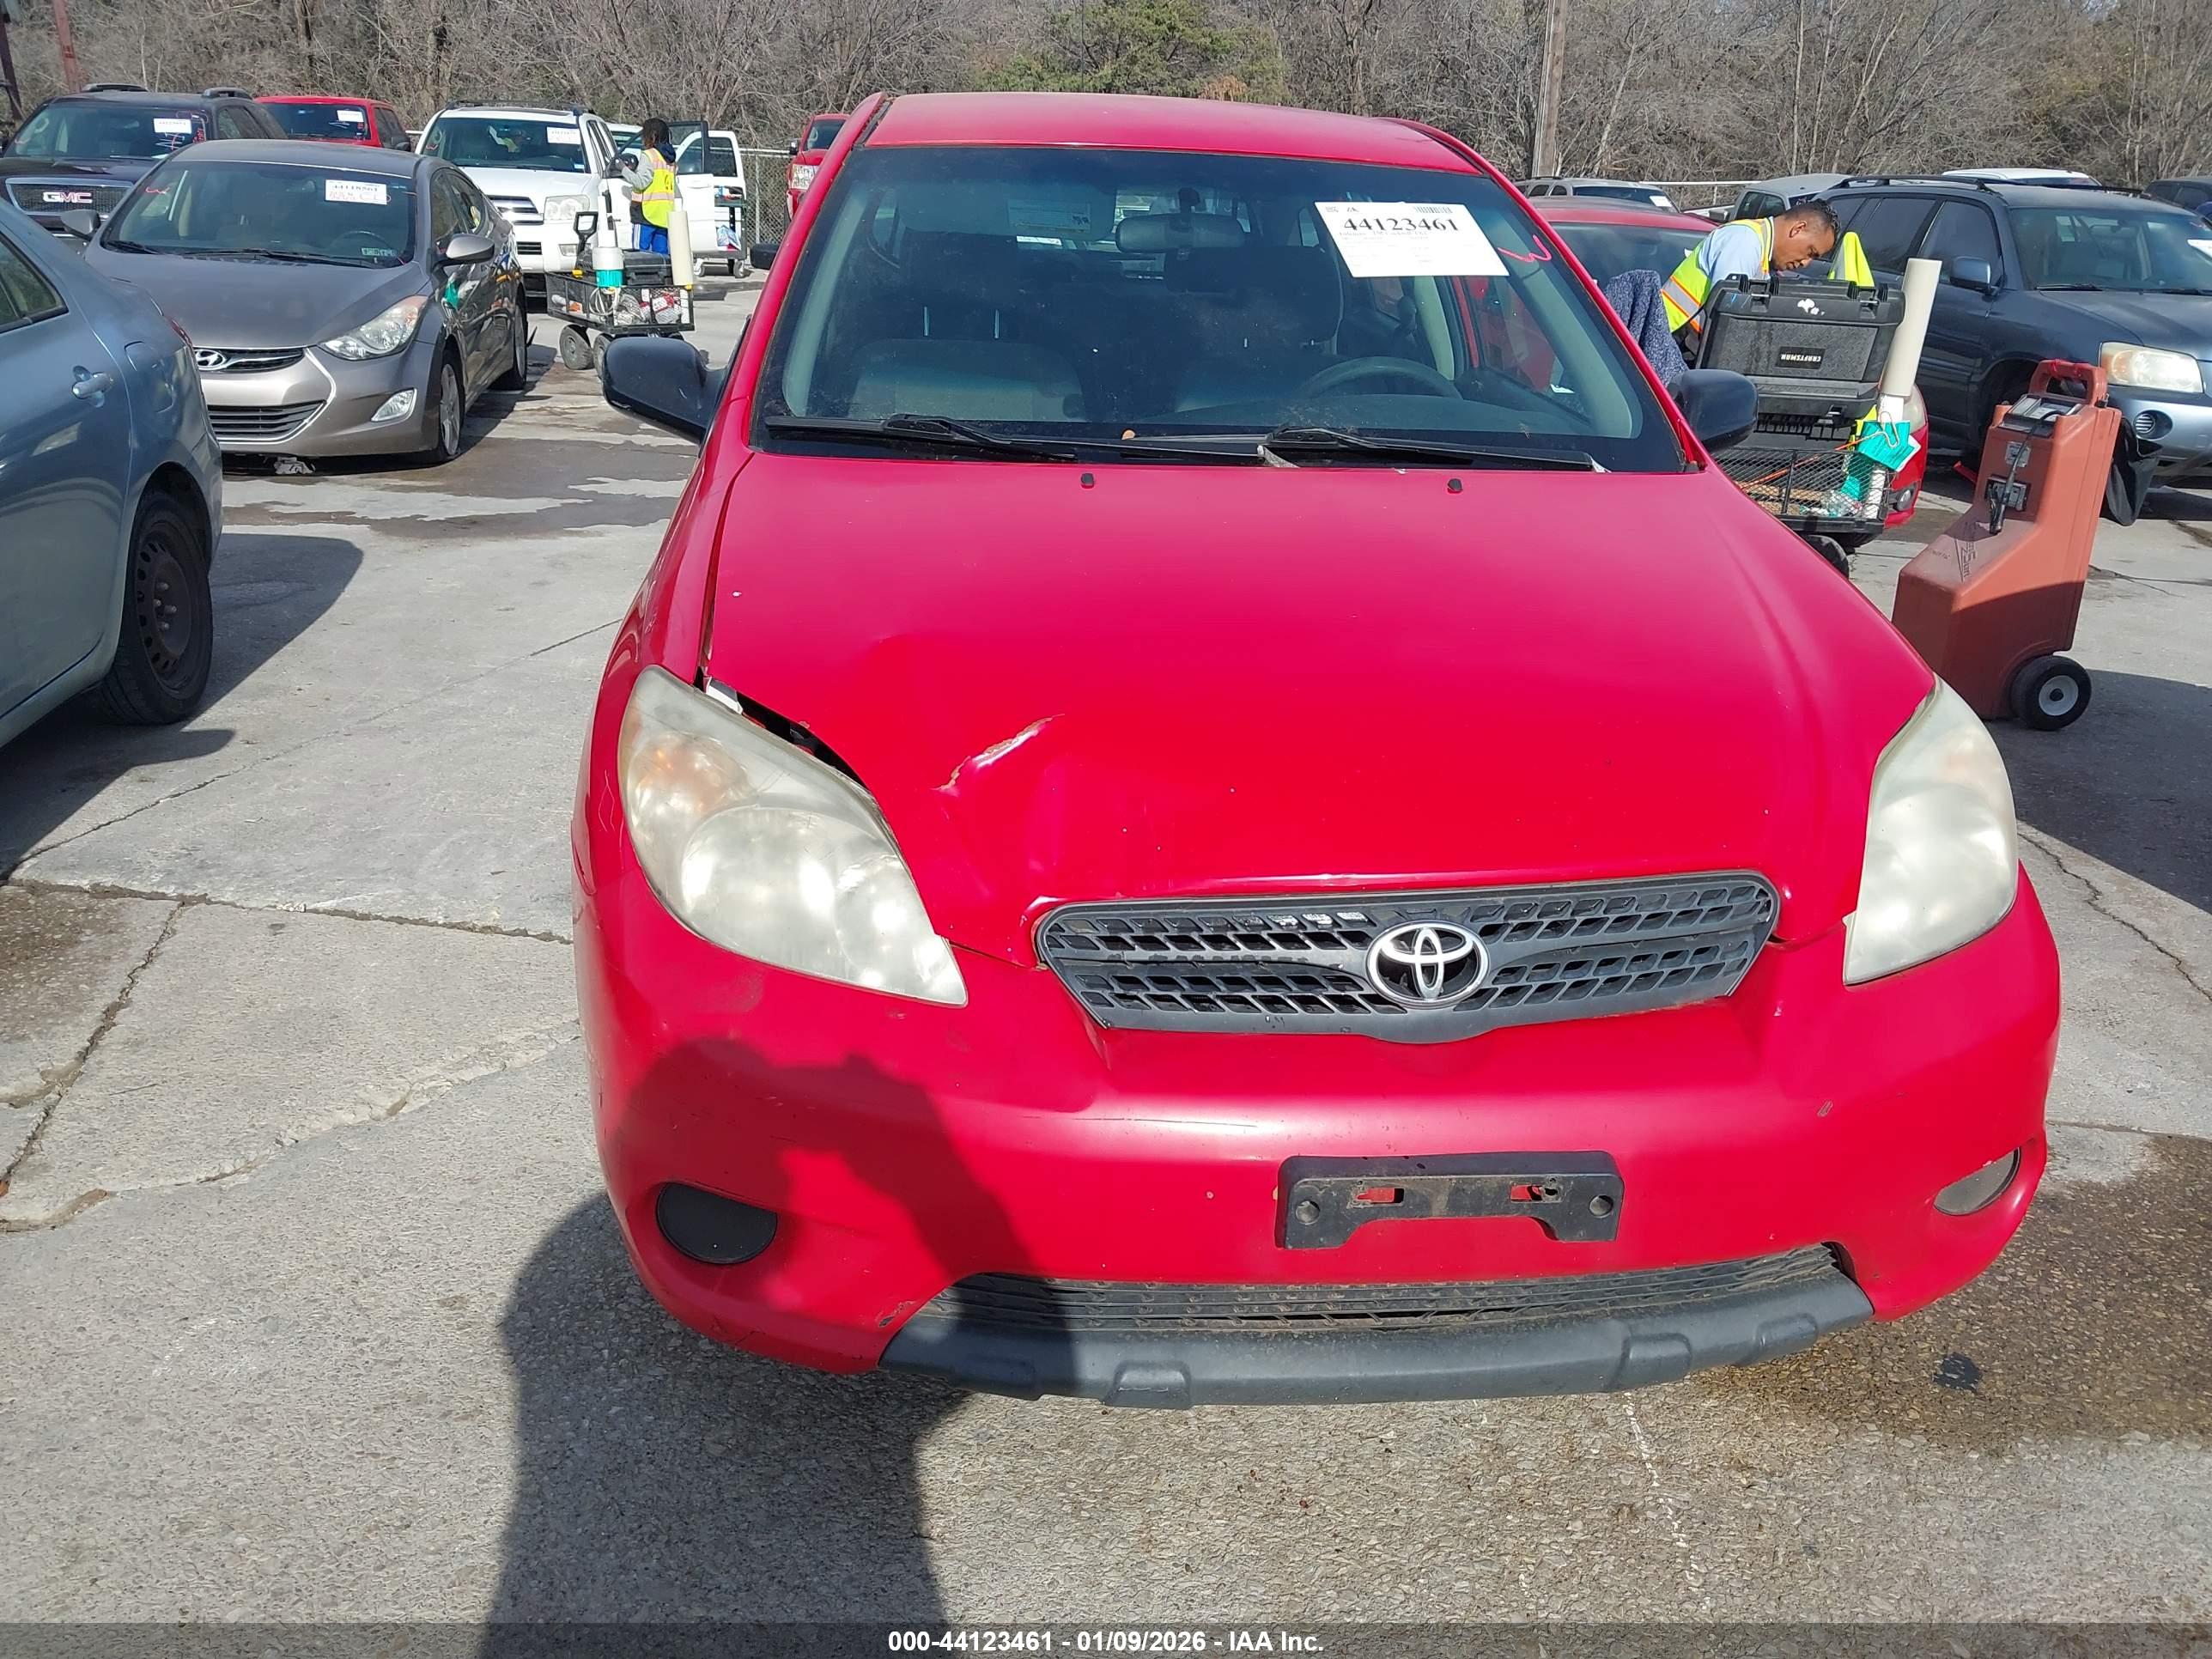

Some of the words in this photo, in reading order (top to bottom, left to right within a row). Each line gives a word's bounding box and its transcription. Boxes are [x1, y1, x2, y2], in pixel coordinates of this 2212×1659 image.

[43, 191, 93, 204] GMC
[1344, 217, 1460, 231] 44123461
[1780, 353, 1821, 362] CRAFTSMAN
